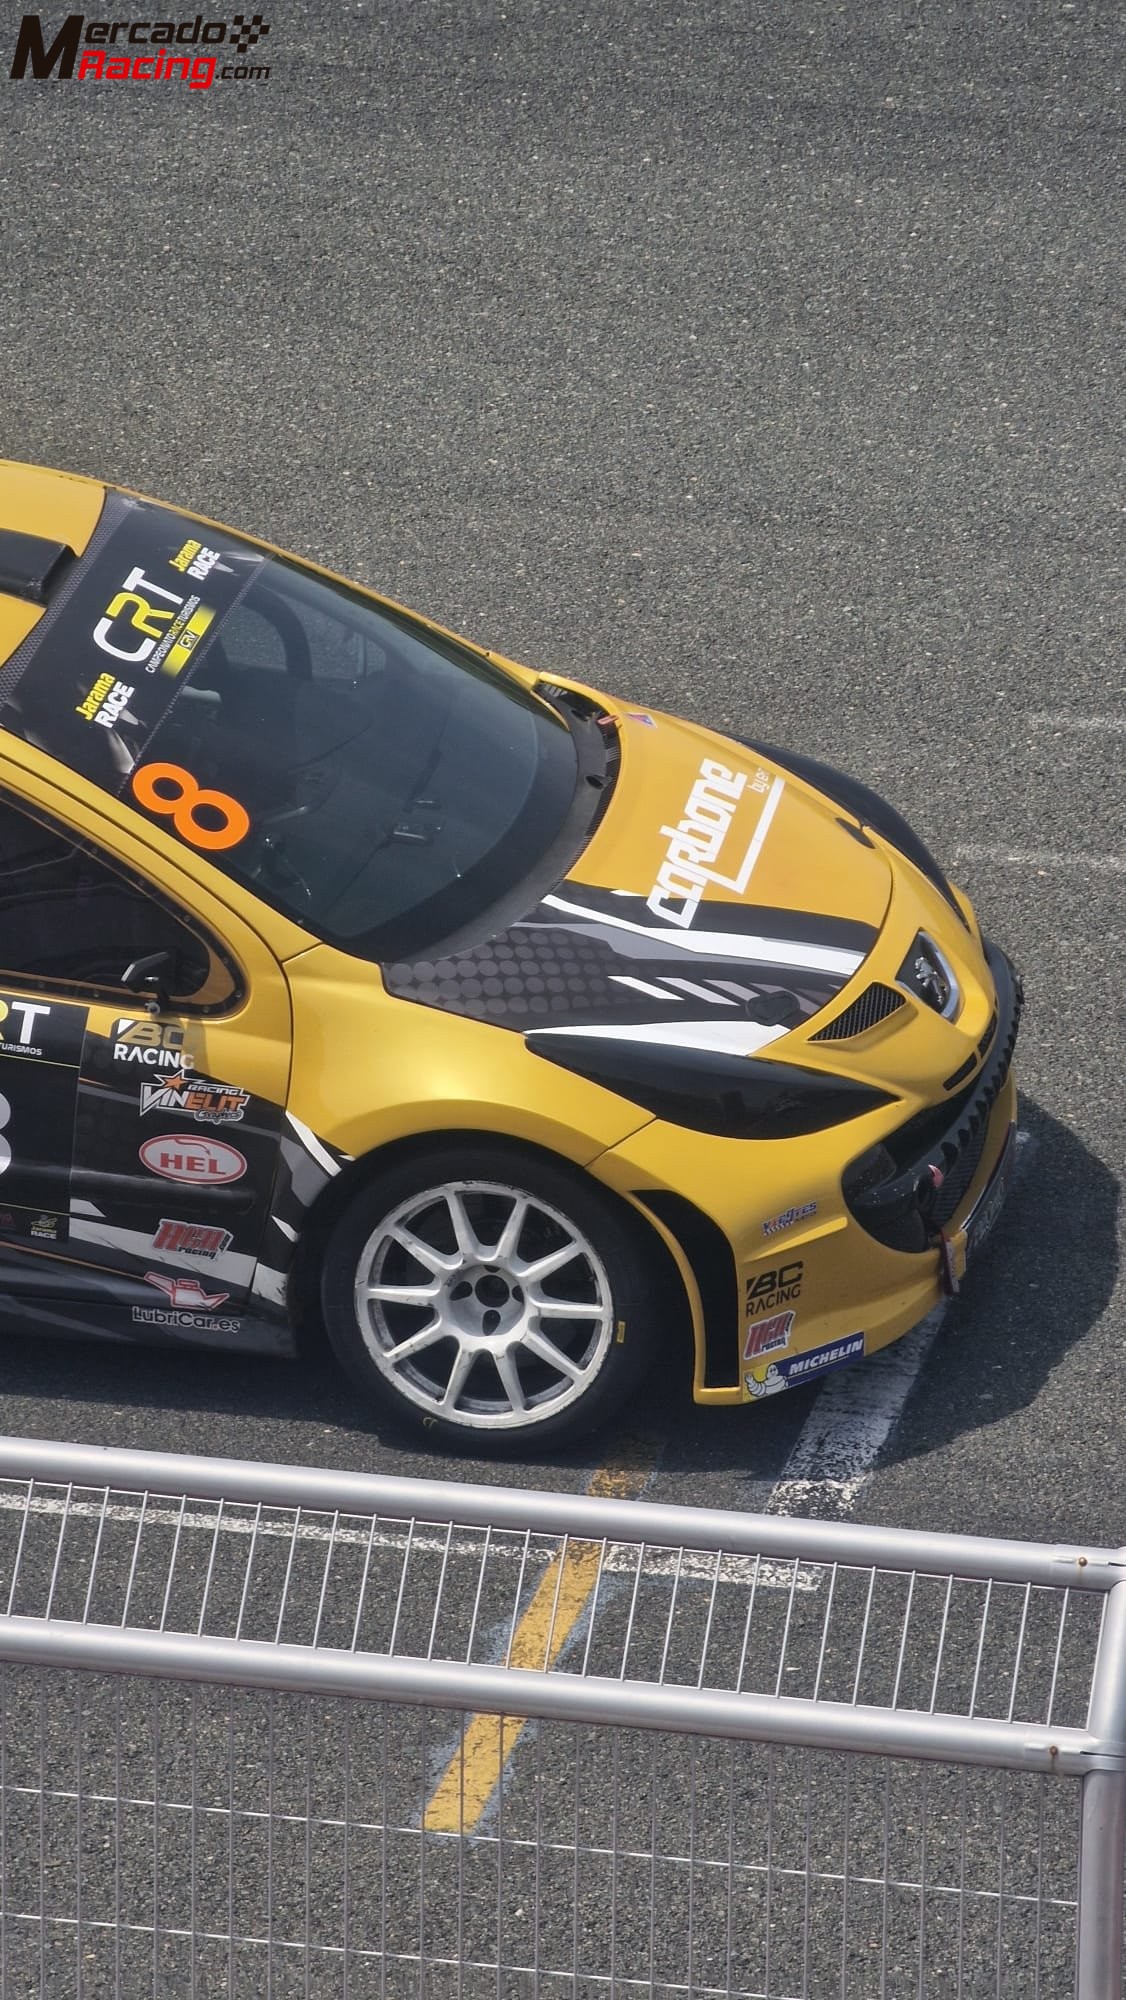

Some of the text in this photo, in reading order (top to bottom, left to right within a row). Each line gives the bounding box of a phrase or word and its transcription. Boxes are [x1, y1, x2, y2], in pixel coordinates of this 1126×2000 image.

[169, 539, 202, 572] Jarama
[187, 546, 221, 580] RACE
[93, 566, 184, 662] CRT
[75, 672, 116, 721] Jarama
[94, 681, 135, 728] RACE
[132, 762, 250, 851] 8
[646, 758, 749, 929] carbone
[0, 1001, 51, 1045] T
[0, 1042, 43, 1056] URISMOS
[113, 1043, 195, 1070] RACING
[186, 1084, 240, 1096] RACING
[160, 1152, 227, 1175] HEL
[745, 1284, 802, 1318] RACING
[132, 1305, 241, 1334] LubriCar.es
[788, 1339, 864, 1376] MICHELIN
